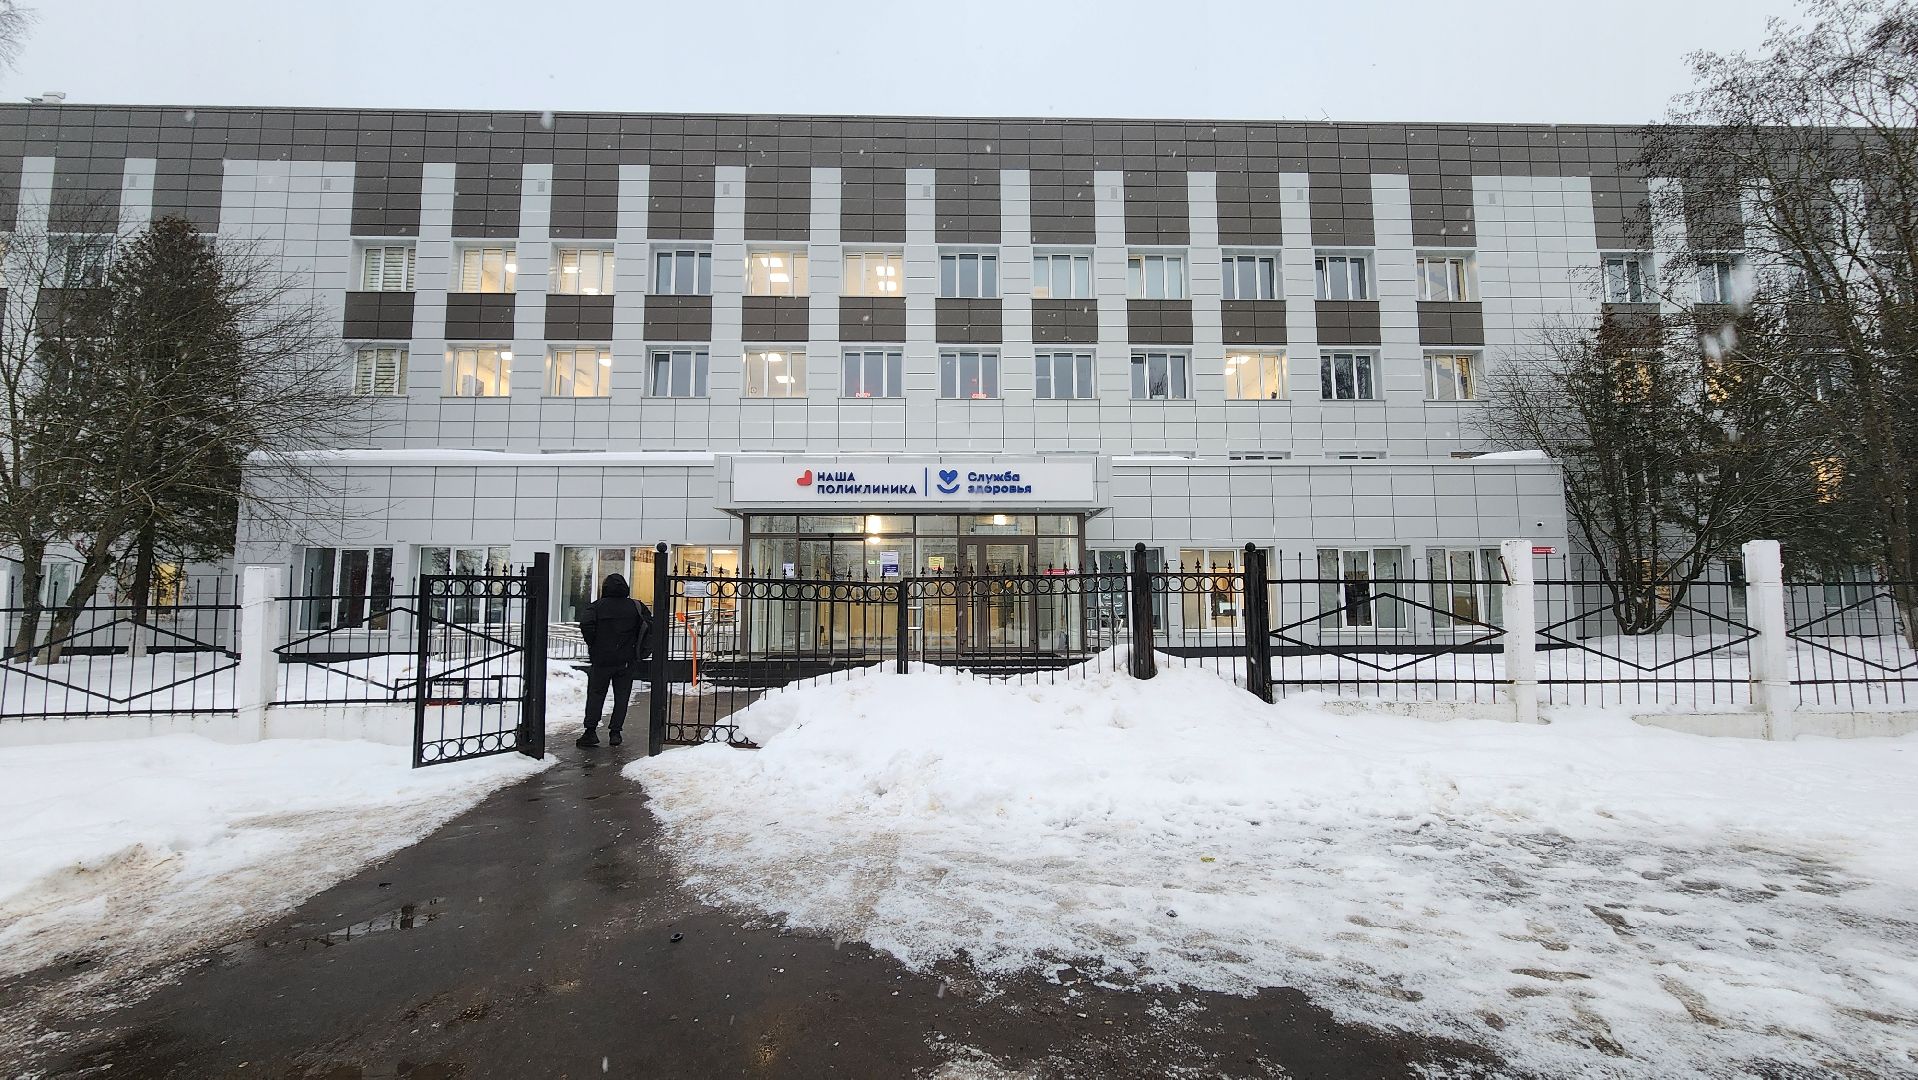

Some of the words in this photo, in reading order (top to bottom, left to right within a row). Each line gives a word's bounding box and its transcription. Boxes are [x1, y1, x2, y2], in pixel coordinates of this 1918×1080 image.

[817, 472, 856, 482] НАША
[967, 471, 1020, 484] Служба
[817, 484, 917, 495] ПОЛИКЛИНИКА
[967, 484, 1032, 496] здоровья
